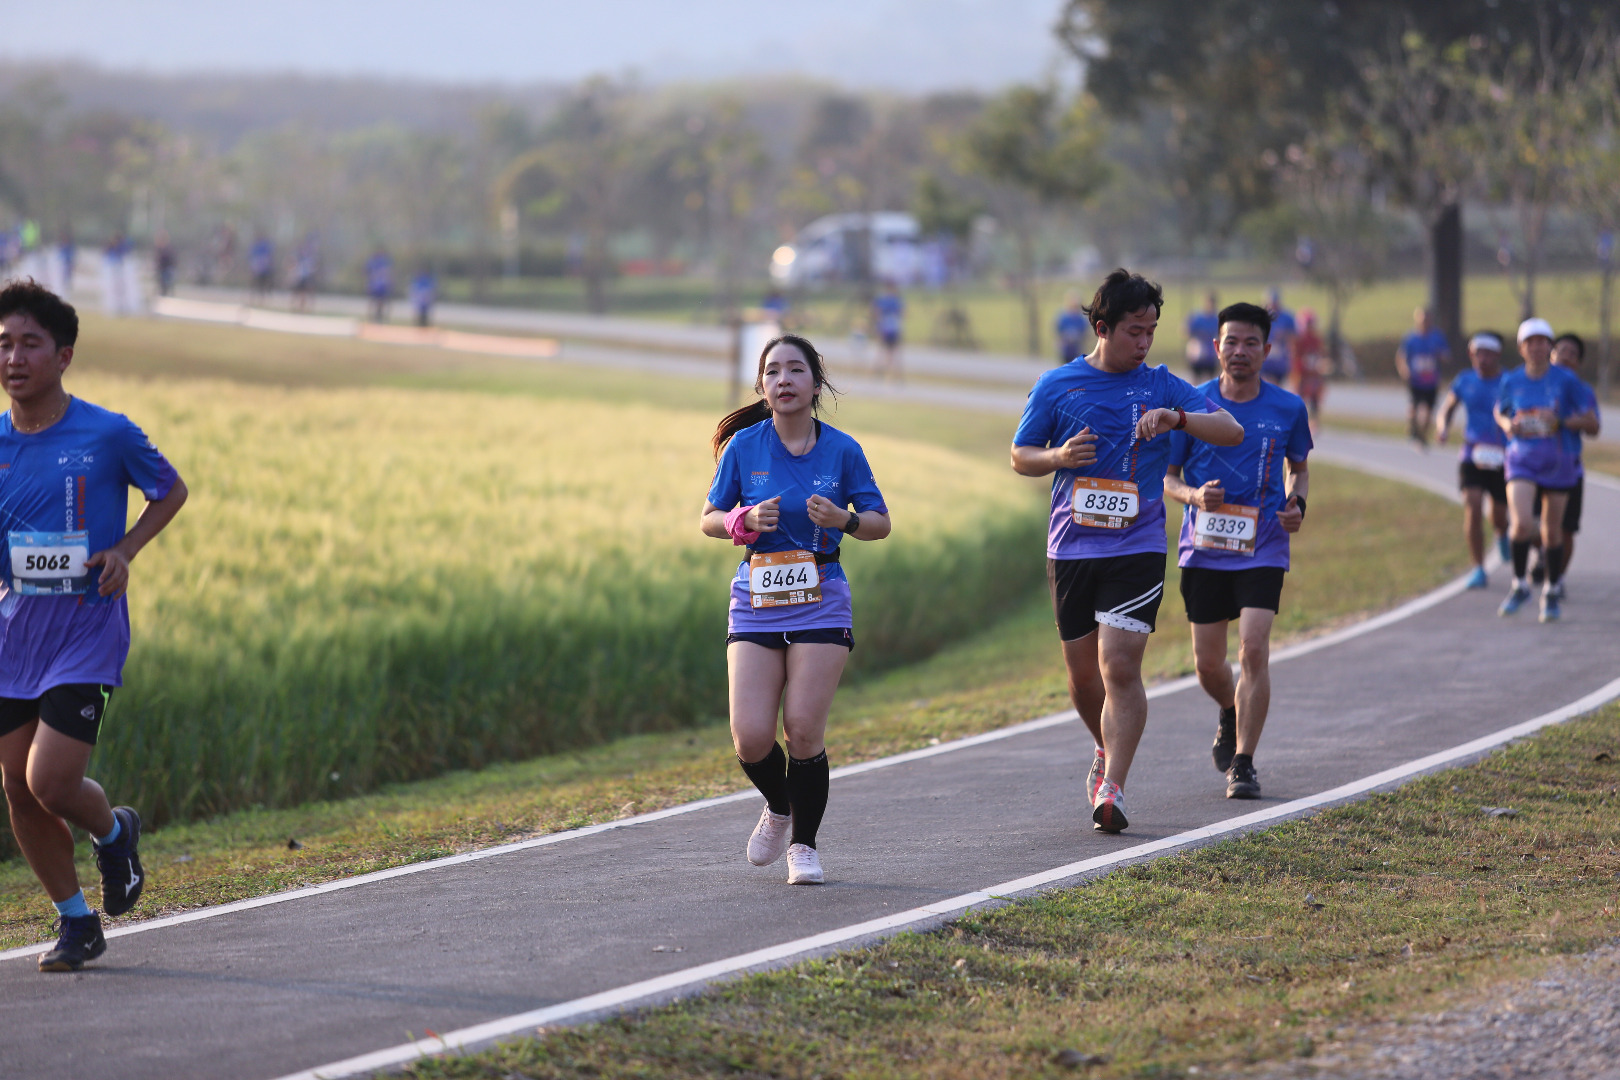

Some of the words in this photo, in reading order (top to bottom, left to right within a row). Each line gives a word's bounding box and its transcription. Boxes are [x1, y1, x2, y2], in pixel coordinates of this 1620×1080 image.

[58, 457, 68, 465] SP
[82, 455, 94, 463] XC
[65, 475, 73, 507] CROSS
[77, 475, 86, 516] SINGHA
[1085, 493, 1130, 512] 8385
[1206, 517, 1246, 535] 8339
[26, 554, 70, 571] 5062
[762, 567, 807, 588] 8464
